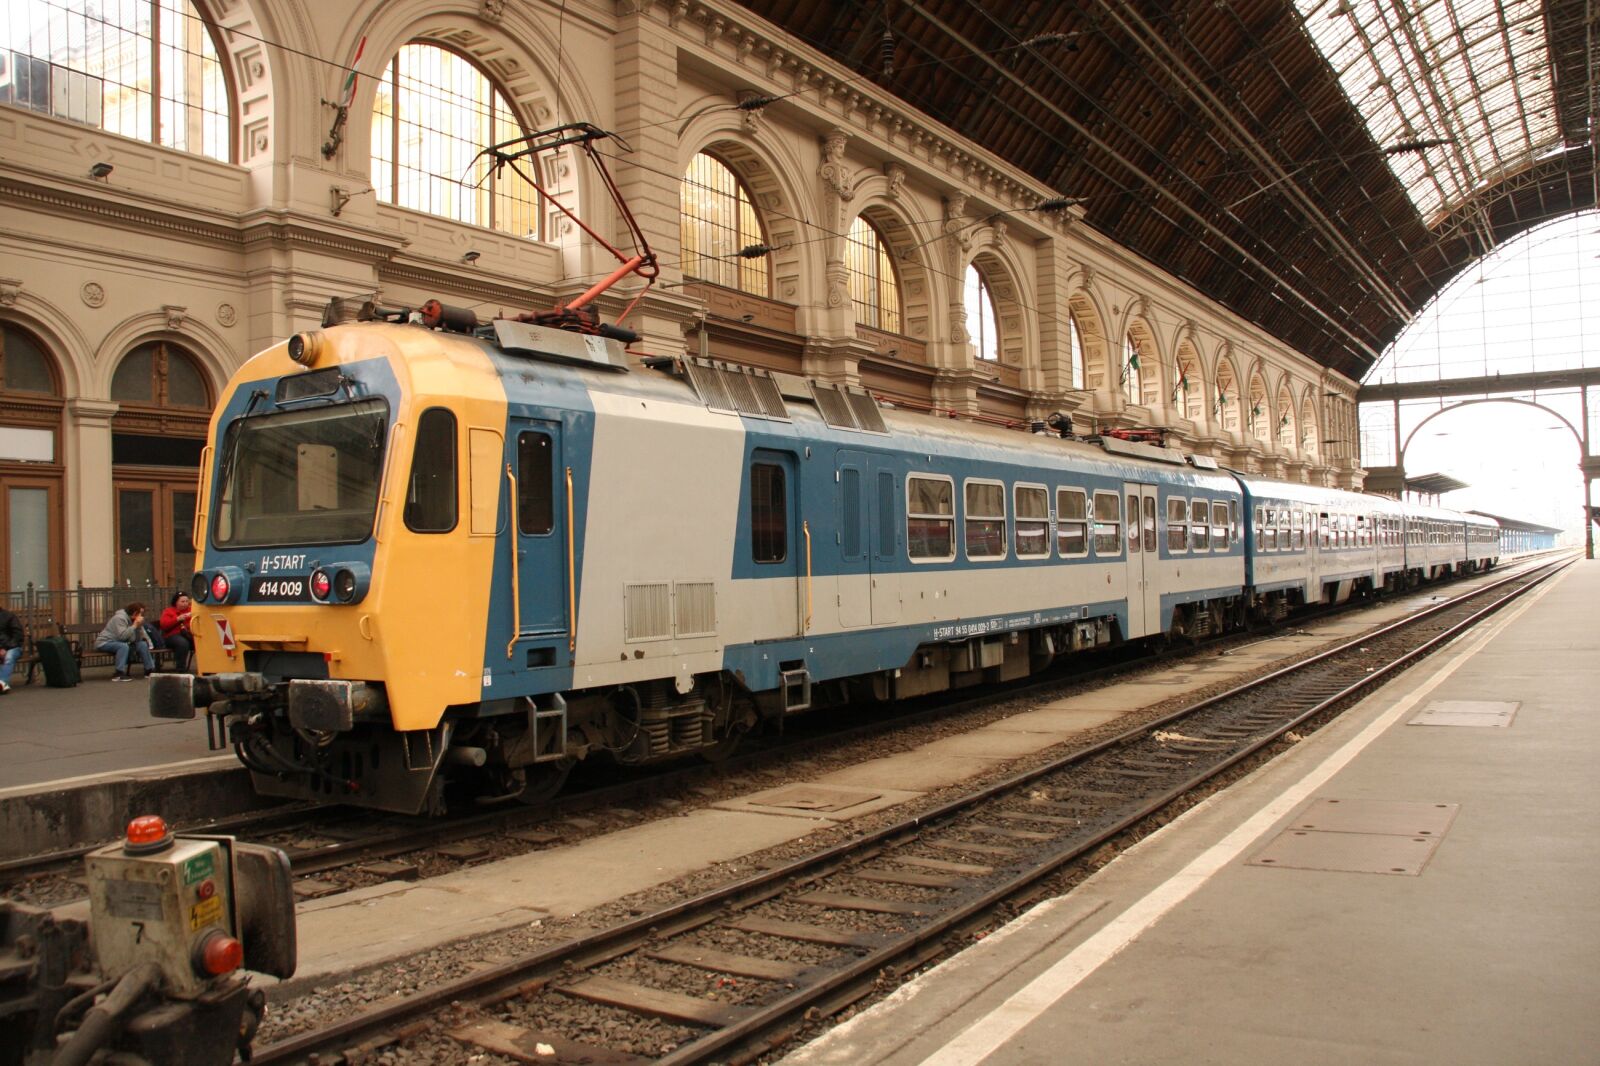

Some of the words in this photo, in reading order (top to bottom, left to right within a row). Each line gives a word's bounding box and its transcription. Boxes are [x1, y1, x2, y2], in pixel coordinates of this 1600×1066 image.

[1087, 498, 1093, 518] 2
[261, 554, 306, 573] H-START
[259, 581, 278, 596] 414
[280, 581, 302, 596] 009
[131, 921, 145, 945] 7
